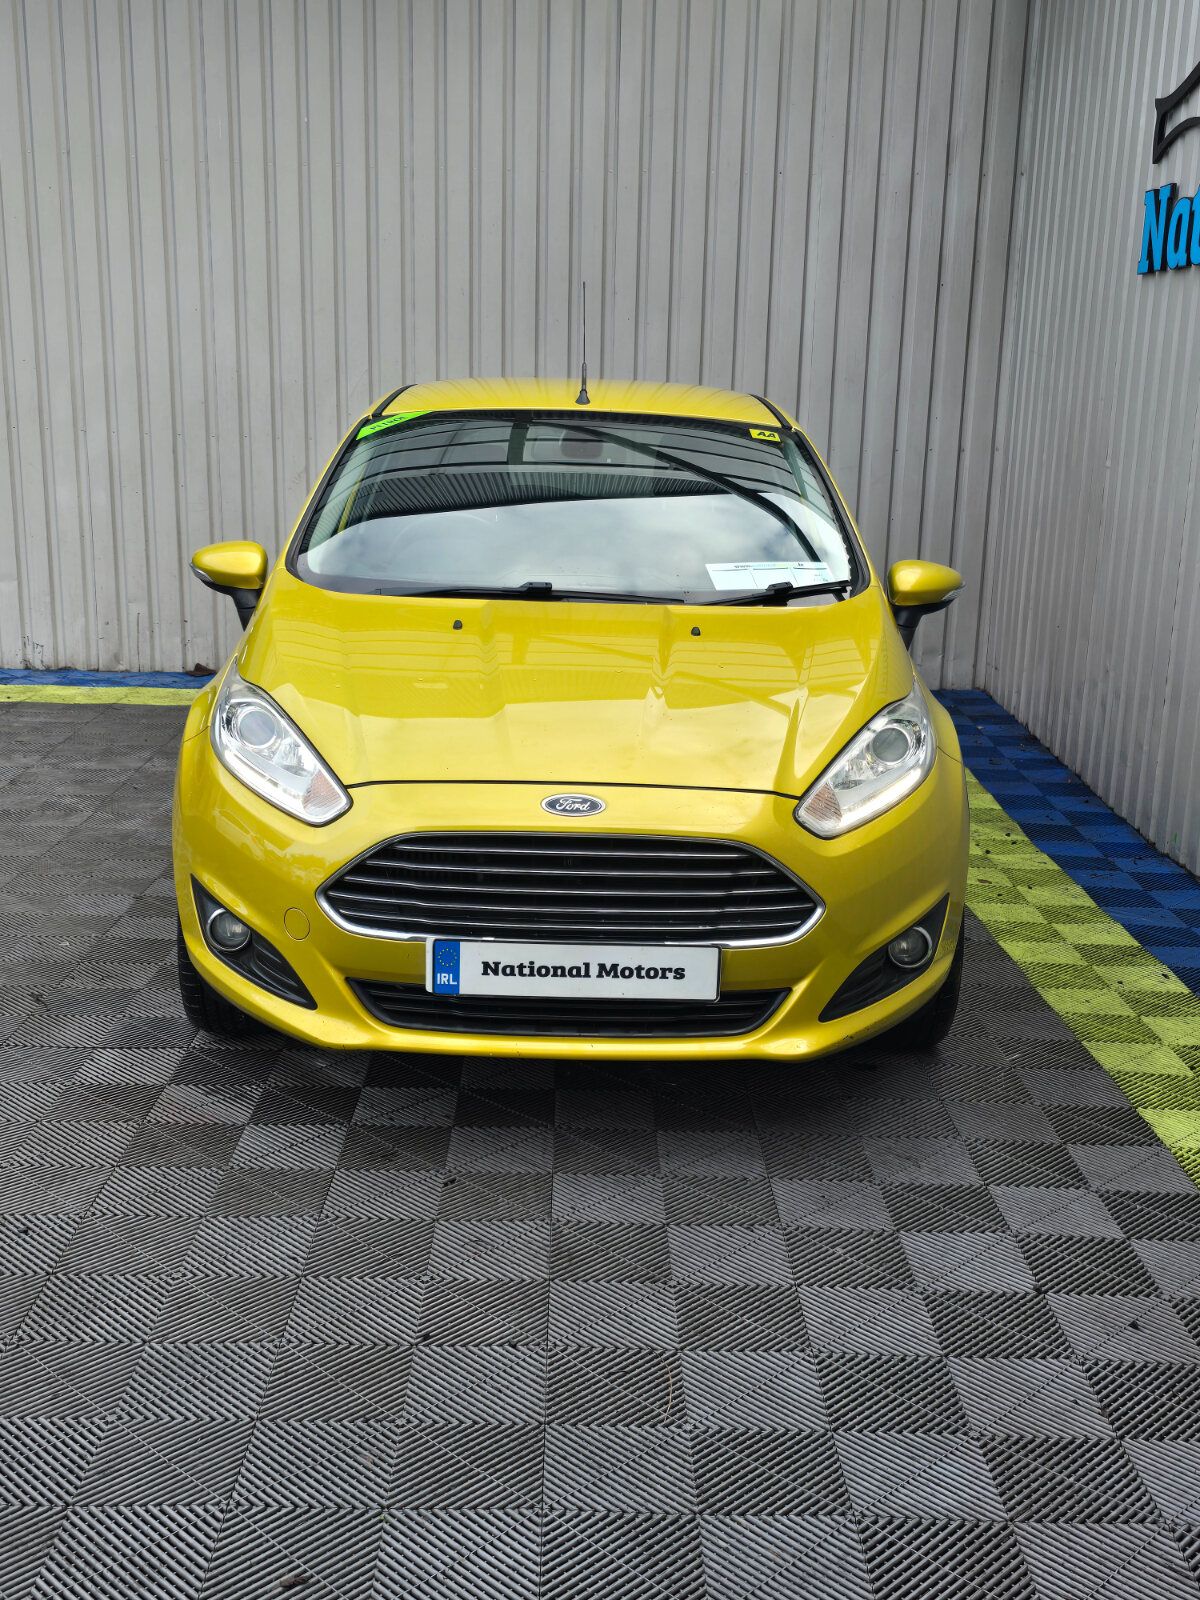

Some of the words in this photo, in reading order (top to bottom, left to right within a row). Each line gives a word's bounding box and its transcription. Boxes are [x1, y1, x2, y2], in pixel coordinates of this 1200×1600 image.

[555, 798, 591, 810] Ford
[481, 960, 592, 978] National
[596, 962, 686, 980] Motors
[437, 973, 457, 985] IRL
